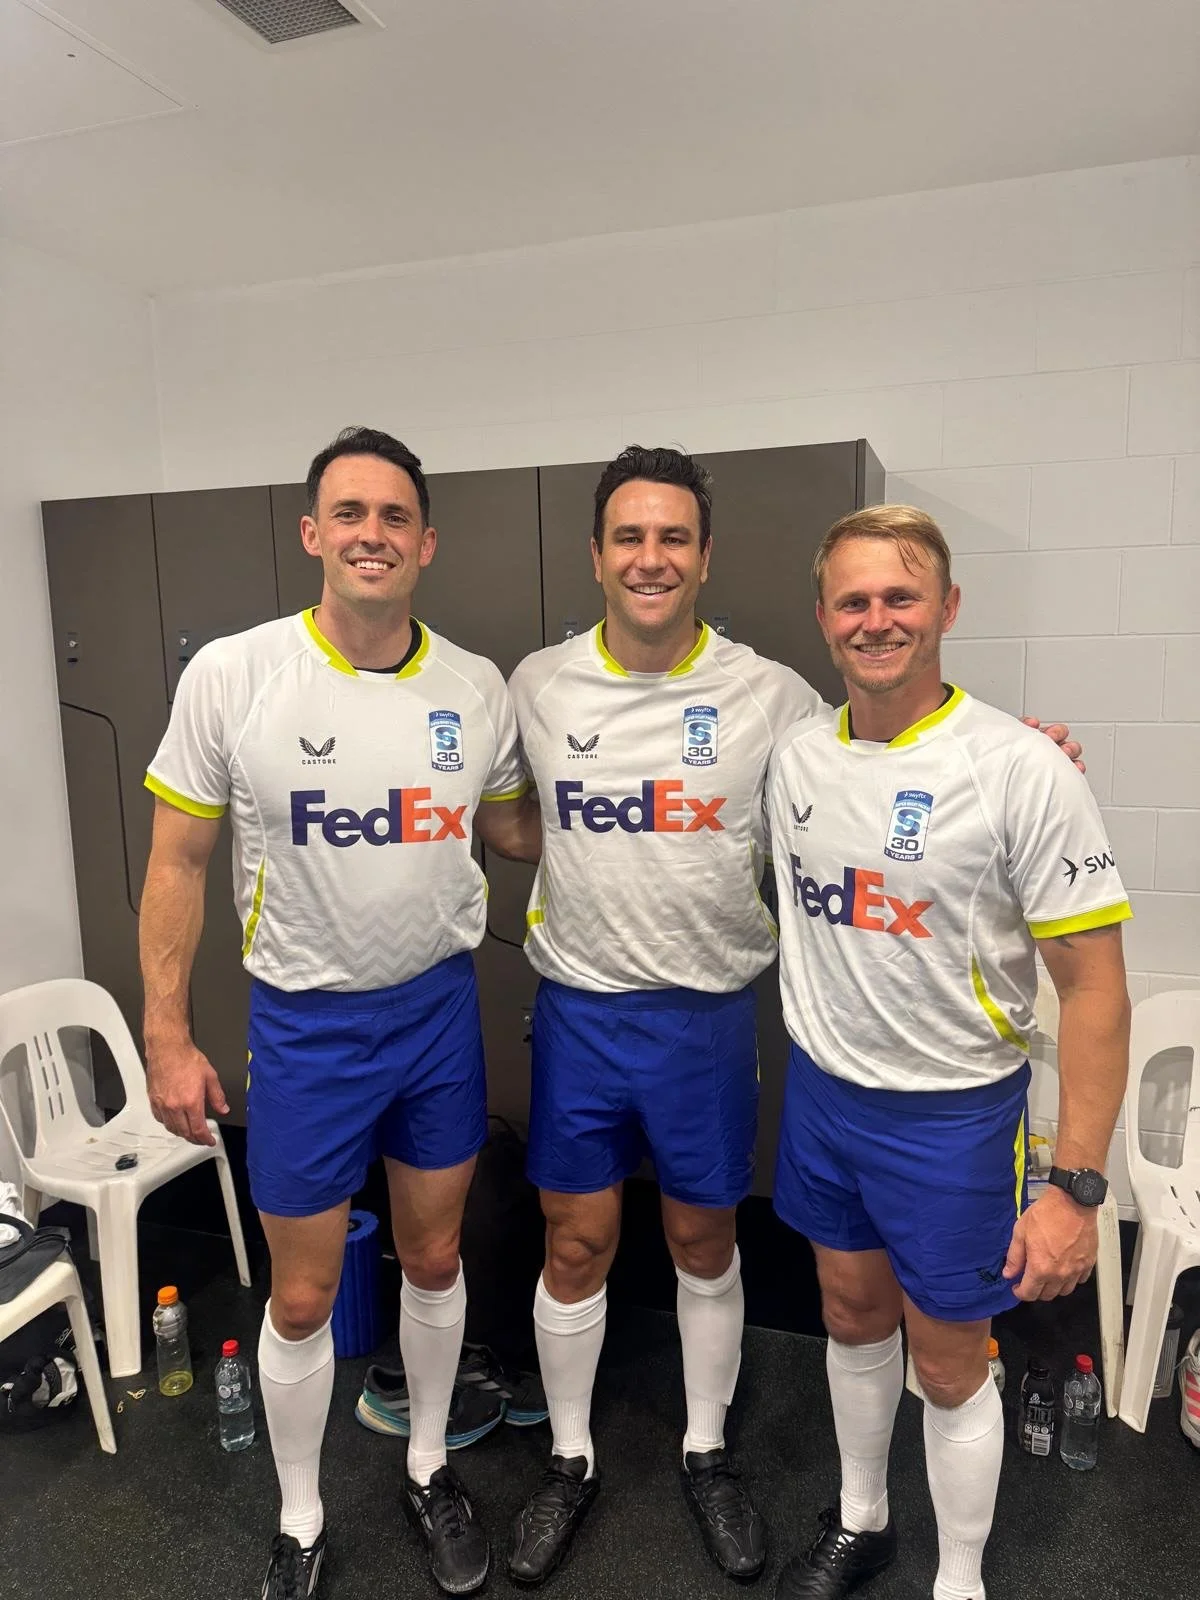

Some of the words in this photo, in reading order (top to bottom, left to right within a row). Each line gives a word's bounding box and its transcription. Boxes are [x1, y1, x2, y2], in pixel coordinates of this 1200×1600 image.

[437, 752, 460, 762] 30
[688, 747, 712, 757] 30
[555, 779, 728, 833] FedEx
[290, 787, 468, 847] FedEx
[891, 837, 919, 851] 30
[890, 851, 916, 860] YEARS
[790, 853, 935, 938] FedEx
